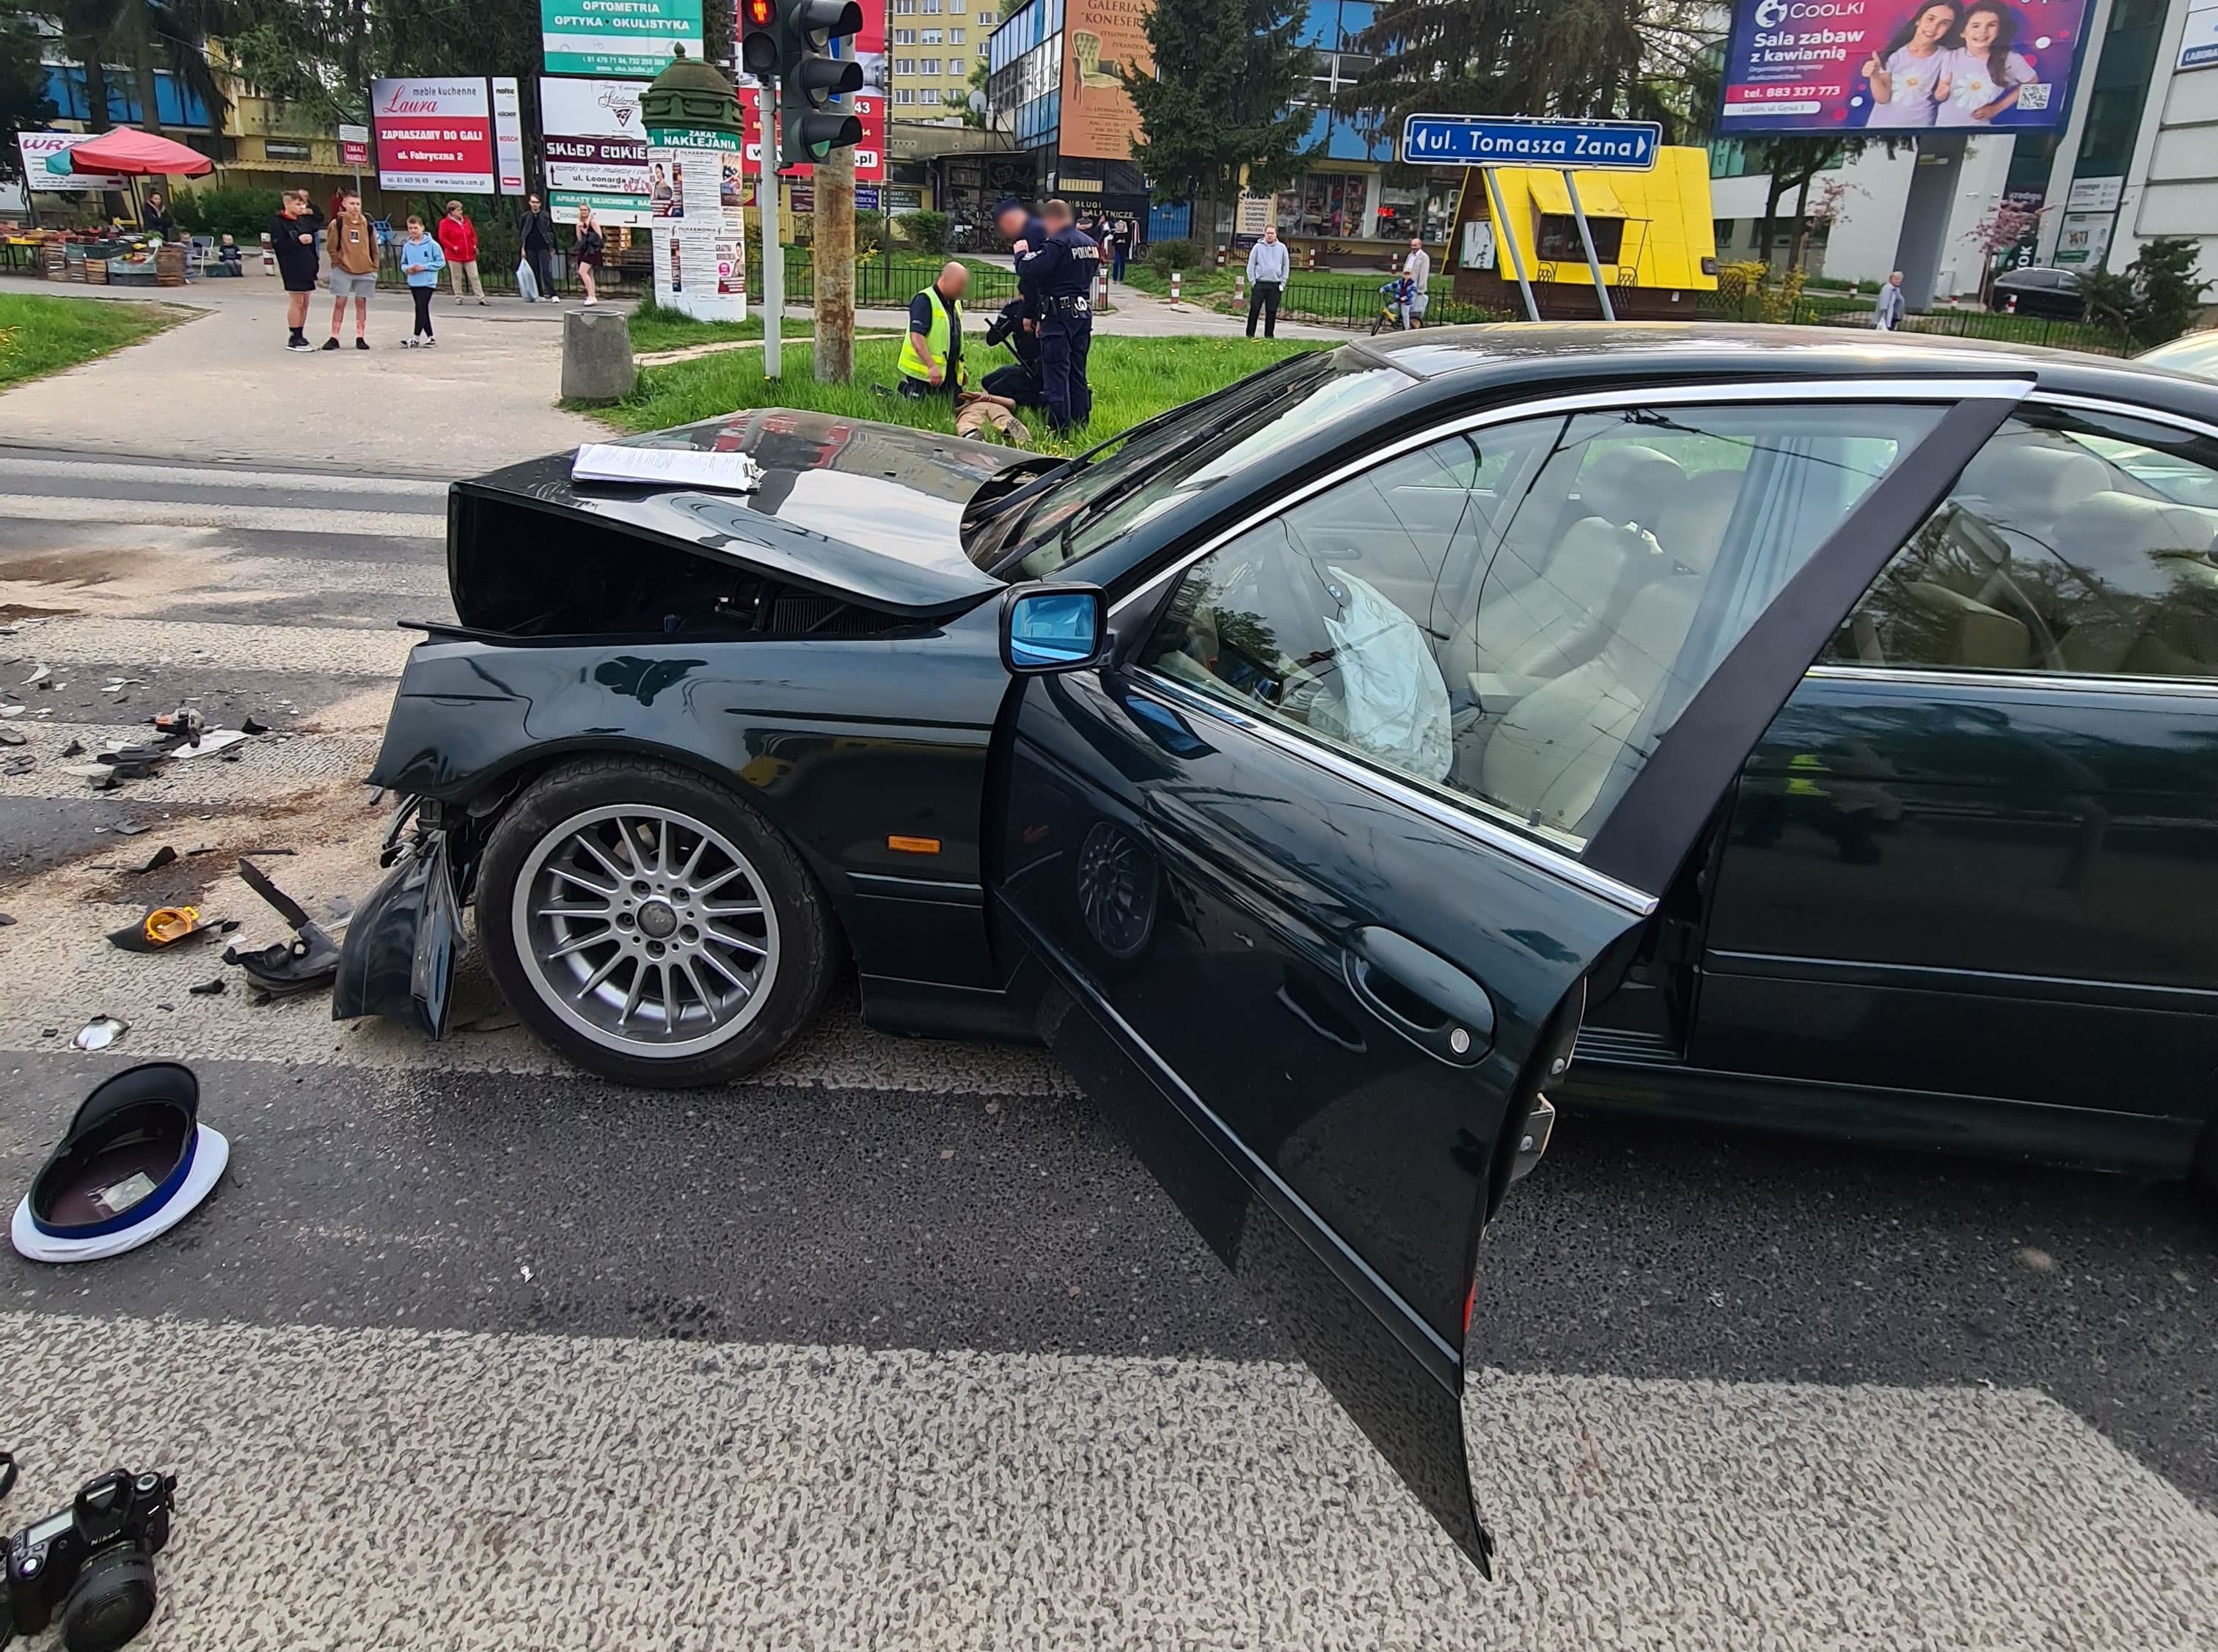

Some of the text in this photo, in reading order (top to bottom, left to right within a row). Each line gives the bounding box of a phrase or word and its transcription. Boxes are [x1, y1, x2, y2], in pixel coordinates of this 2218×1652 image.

[582, 1, 661, 13] OPTOMETRIA
[1088, 0, 1138, 13] GALERIA
[1790, 1, 1865, 19] COOLKI
[554, 15, 691, 31] OPTYKA OKULISTYKA
[1754, 28, 1865, 48] Sala zabaw
[1750, 45, 1847, 63] z kawiarnią
[412, 87, 477, 96] meble kuchenne
[1743, 84, 1841, 99] tel. 883 337 773
[381, 85, 439, 114] Laura
[381, 129, 441, 141] ZAPRASZAMY
[443, 131, 458, 141] DO
[689, 130, 717, 139] ZAKAZ
[663, 136, 737, 150] NAKLEJANIA
[1430, 128, 1631, 157] ul. Tomasza Zana
[397, 151, 464, 163] ul. Fabryczna 2
[546, 142, 595, 158] SKLEP
[572, 174, 584, 183] ul.
[586, 175, 626, 185] Leonarda
[1069, 200, 1102, 209] SŁUGI
[1072, 246, 1100, 260] POLICJA
[90, 1528, 121, 1546] Nikon
